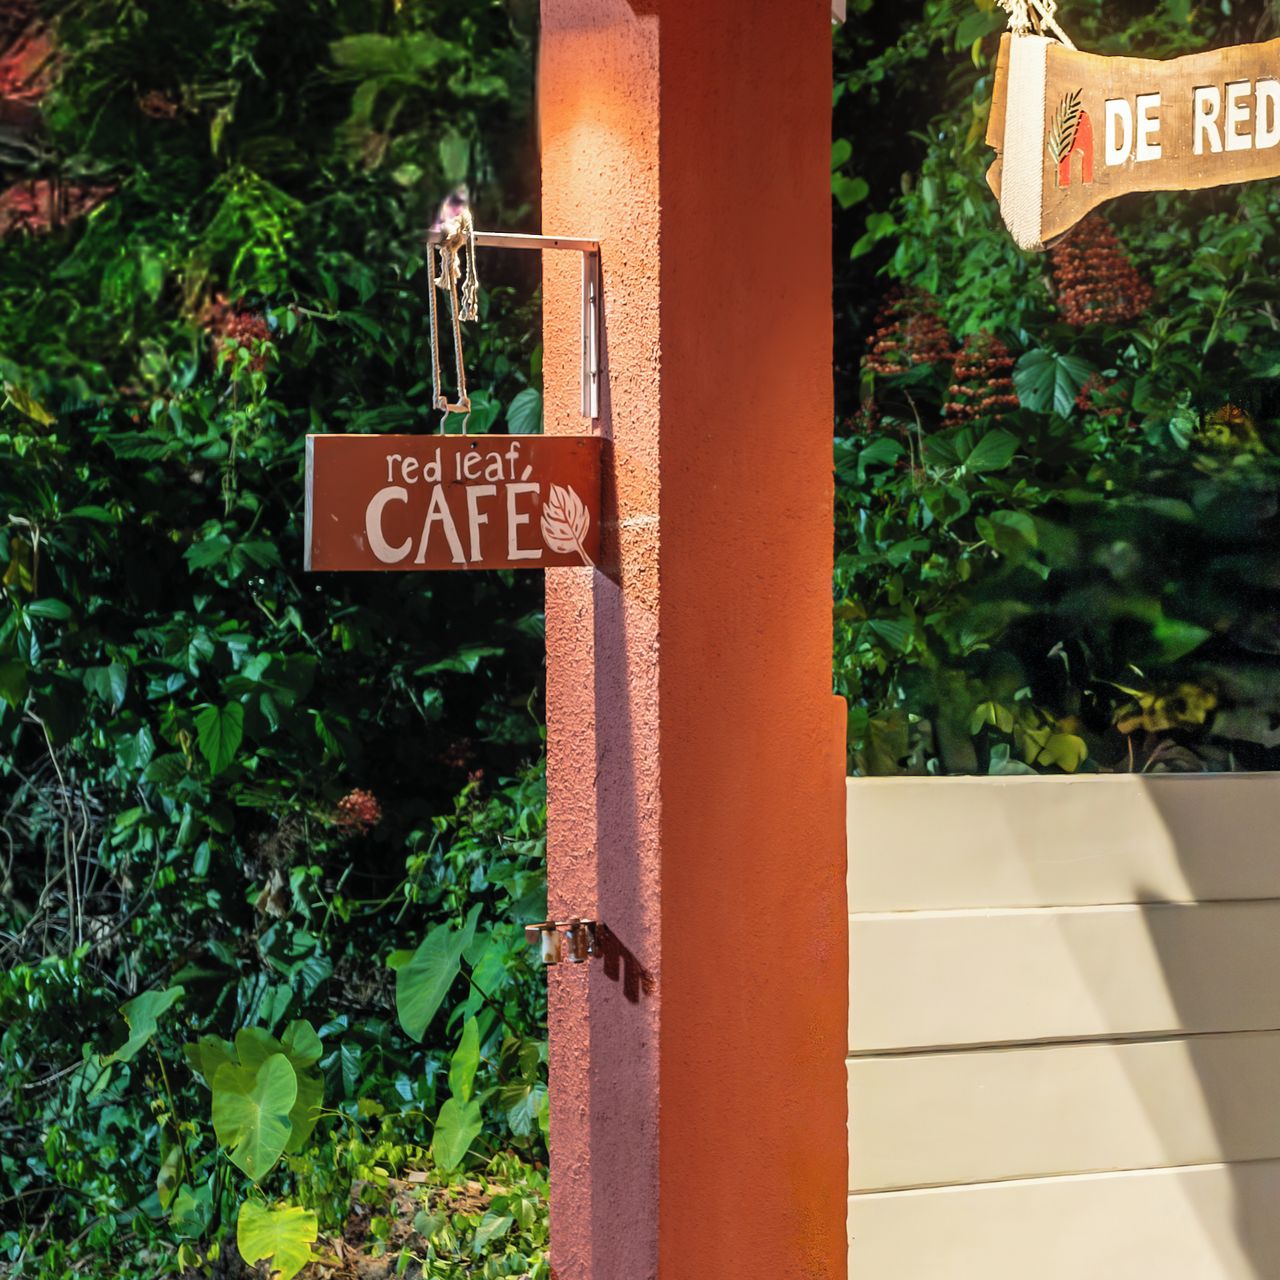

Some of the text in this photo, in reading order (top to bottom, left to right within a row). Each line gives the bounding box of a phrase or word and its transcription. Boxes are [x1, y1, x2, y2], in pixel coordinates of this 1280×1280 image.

[1105, 91, 1161, 166] DE
[386, 441, 520, 484] red leaf
[365, 465, 543, 564] CAFÉ
